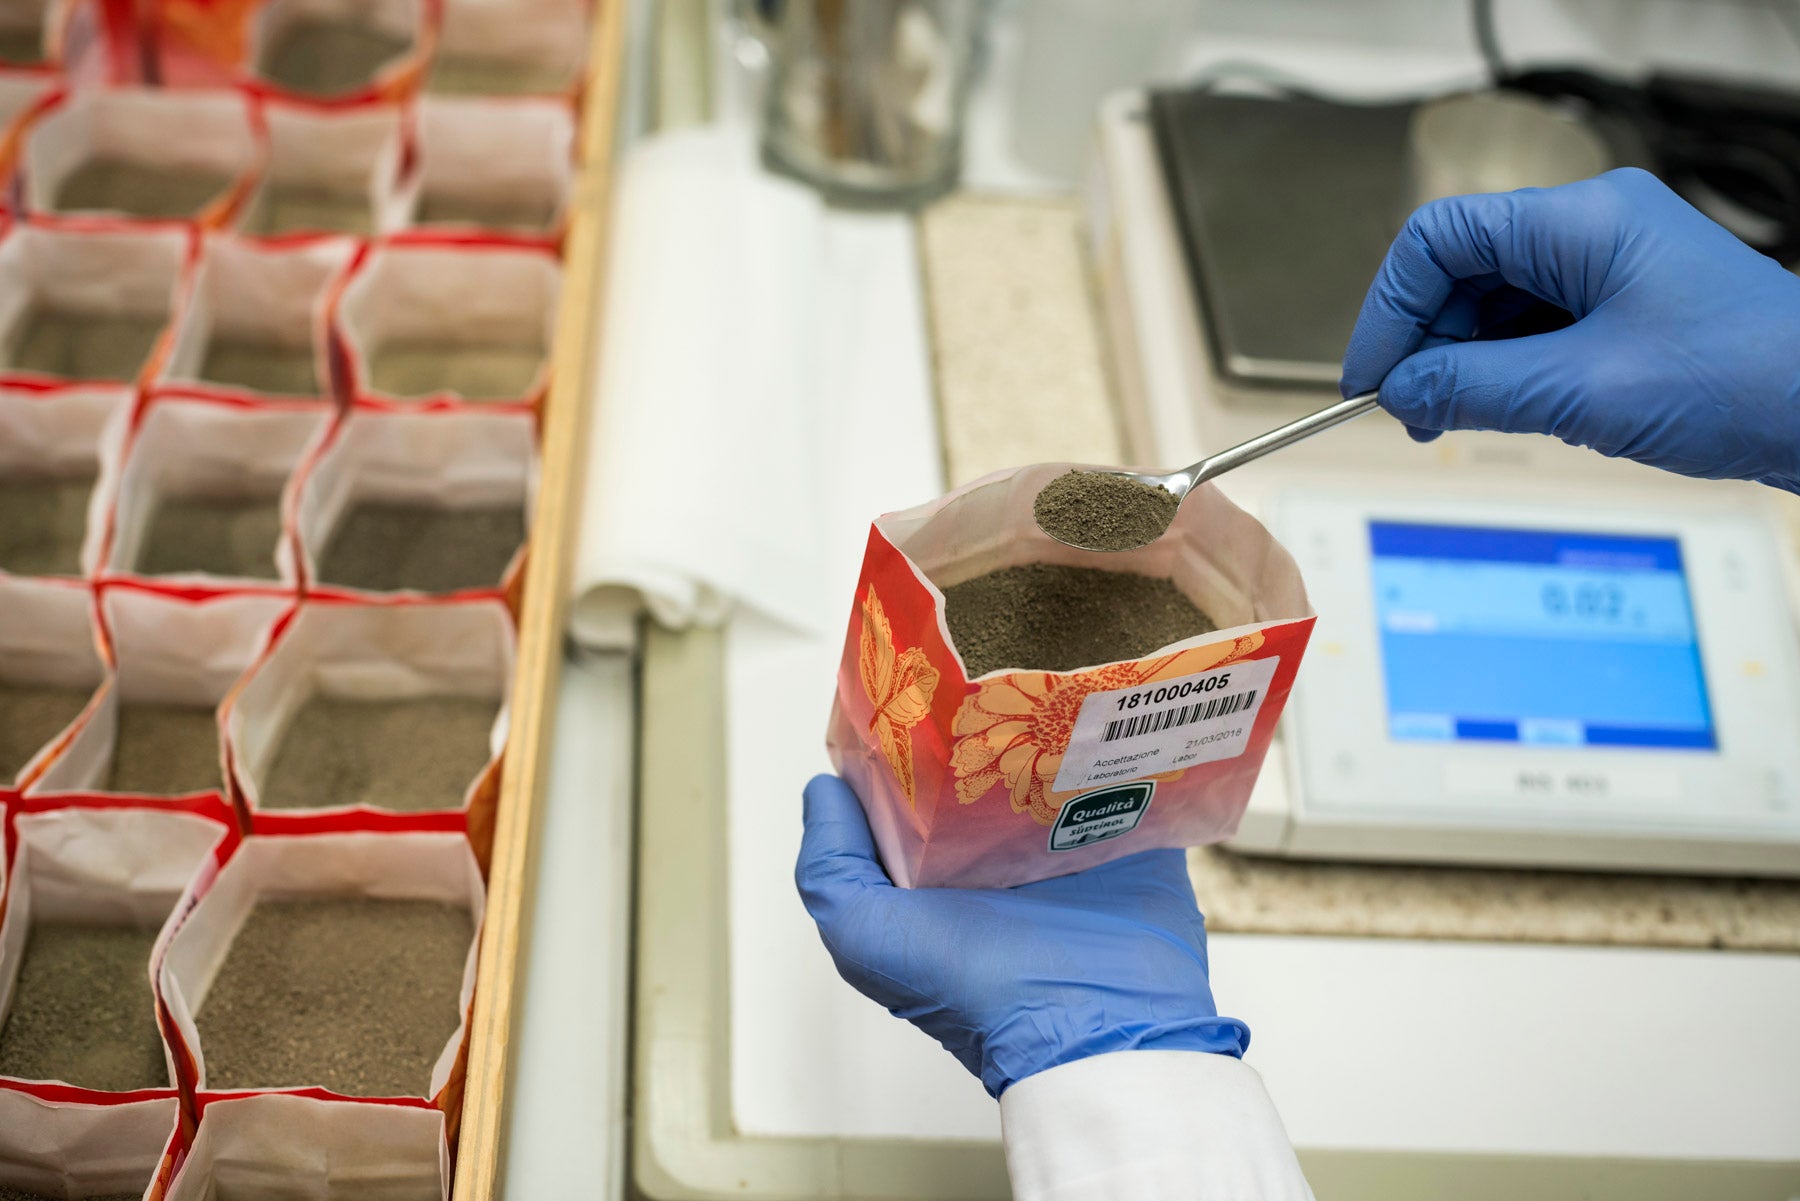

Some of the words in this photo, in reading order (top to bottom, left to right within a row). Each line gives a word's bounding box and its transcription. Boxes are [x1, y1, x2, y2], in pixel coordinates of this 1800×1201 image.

[1117, 673, 1231, 711] 181000405
[1185, 728, 1242, 749] 21/03/2018
[1093, 748, 1160, 768] Accettazione
[1172, 752, 1197, 764] Labor
[1087, 766, 1138, 781] Laboratorio
